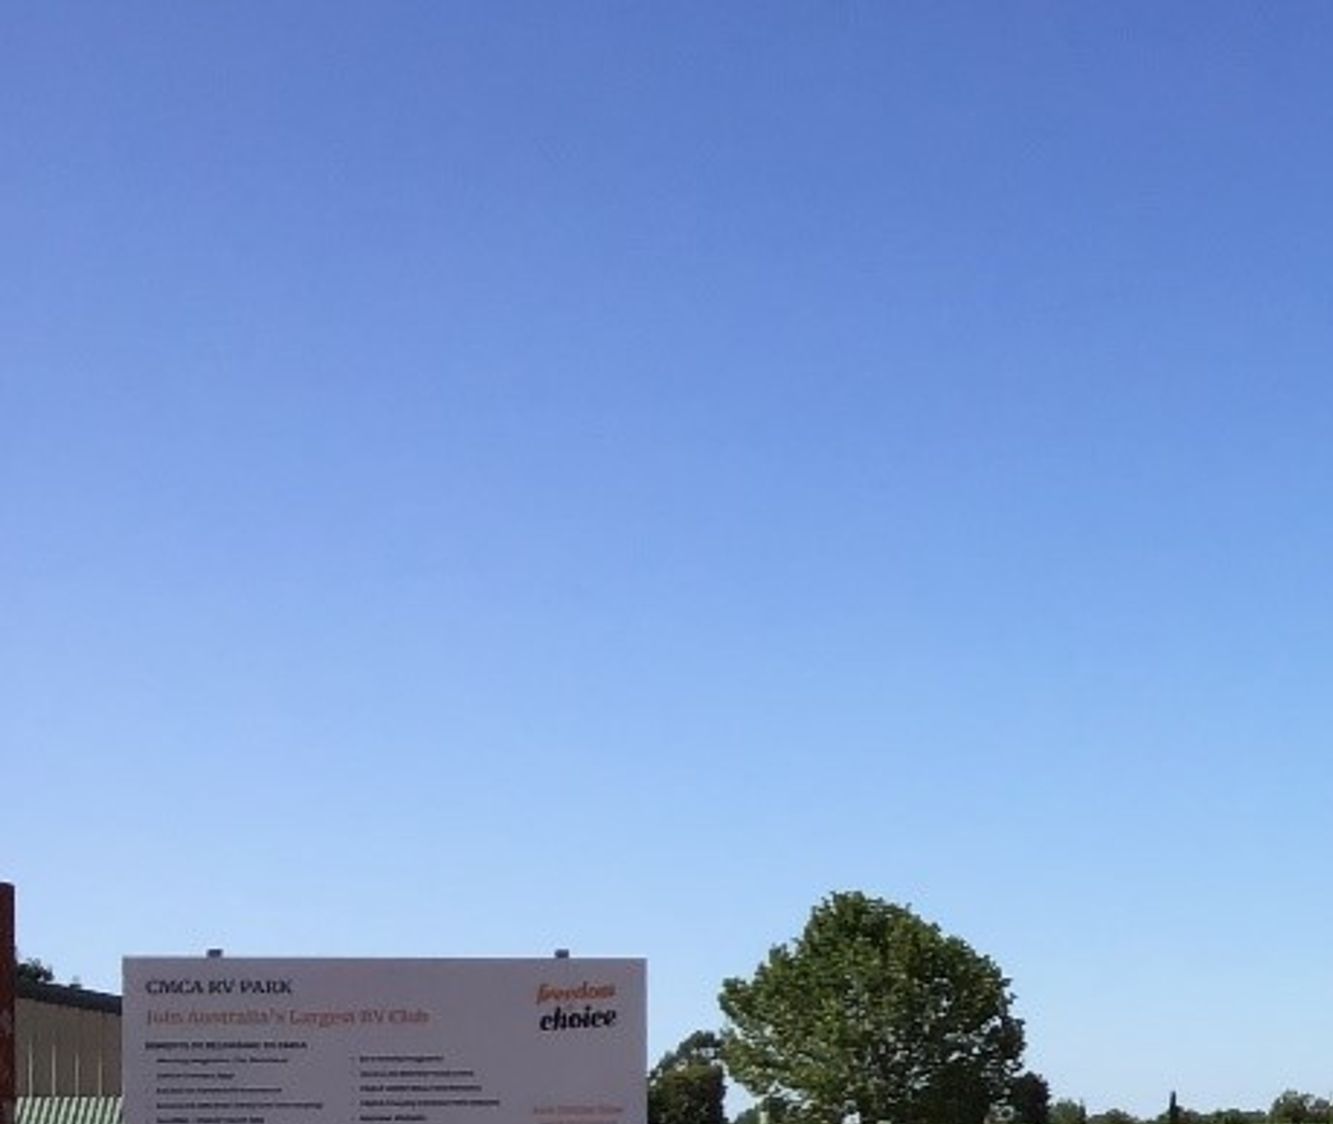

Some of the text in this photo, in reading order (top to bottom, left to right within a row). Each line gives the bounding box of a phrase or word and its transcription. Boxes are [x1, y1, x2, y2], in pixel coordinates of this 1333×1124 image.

[145, 979, 293, 994] CMCA RV PARK
[536, 981, 616, 1005] freedom
[147, 1007, 430, 1028] Join Australia's Largest RV Club
[540, 1005, 617, 1031] choice
